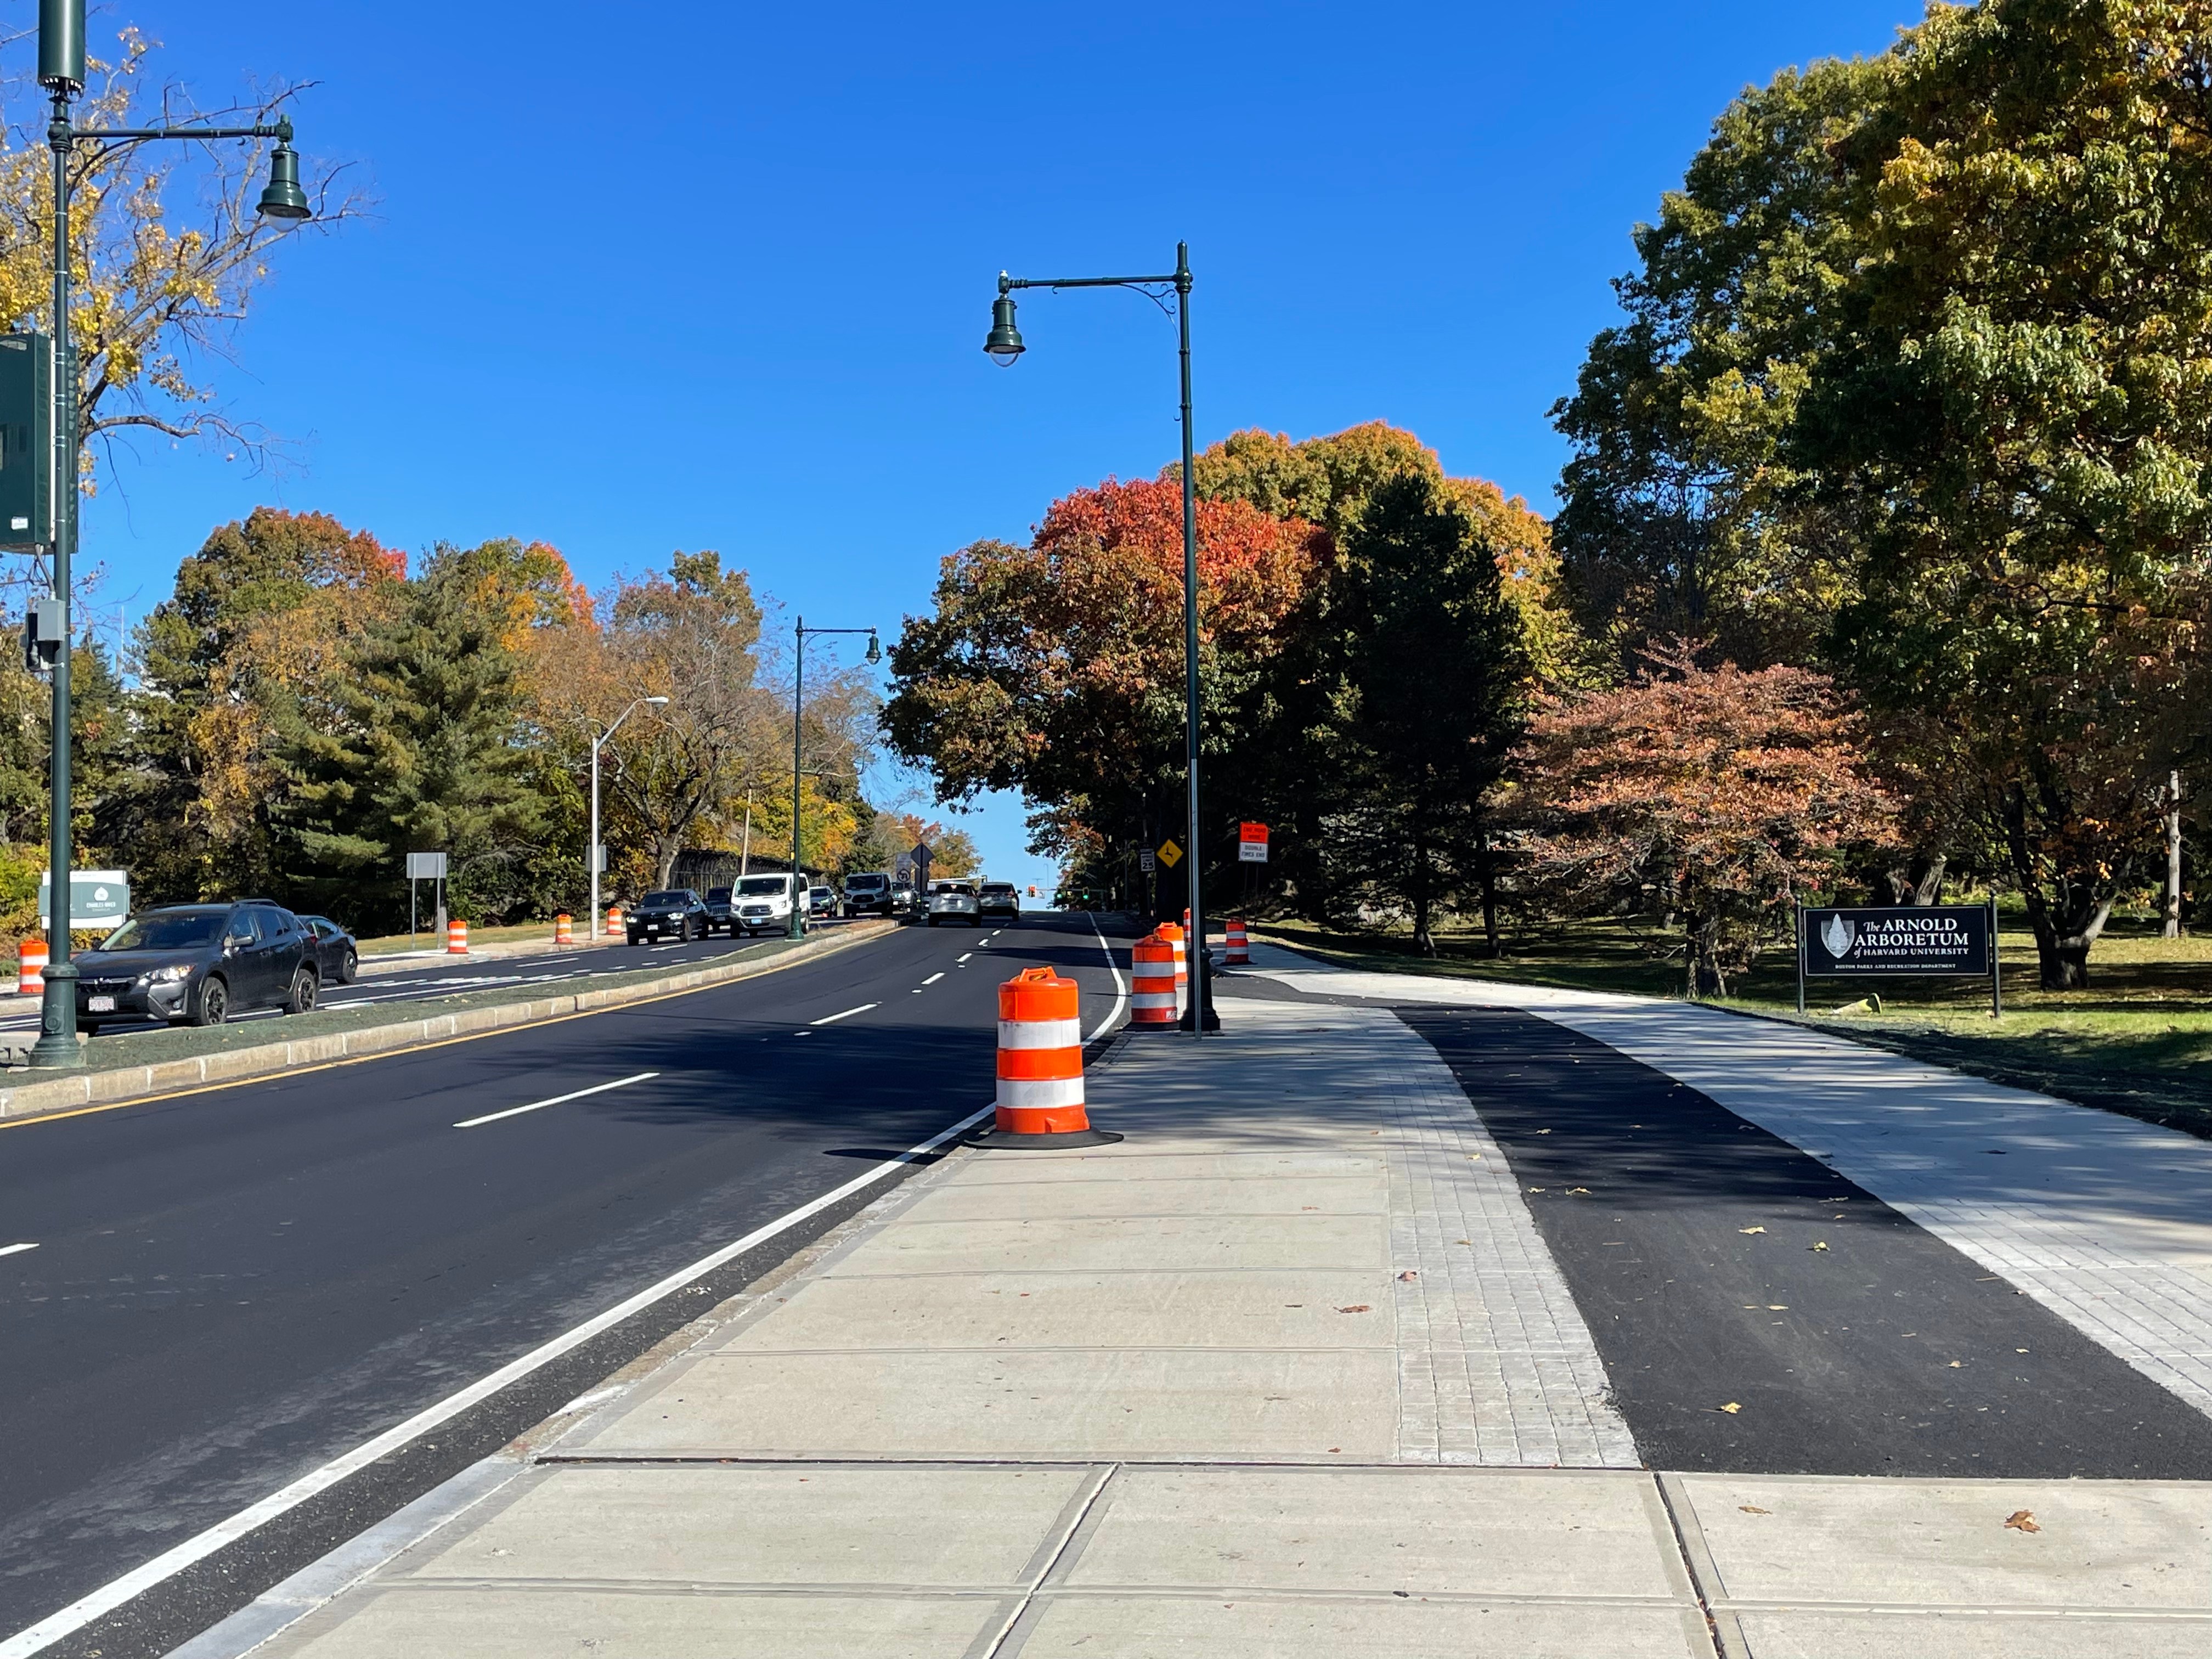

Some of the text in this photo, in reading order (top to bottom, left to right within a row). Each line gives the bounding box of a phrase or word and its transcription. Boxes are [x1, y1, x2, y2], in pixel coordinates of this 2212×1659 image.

[1863, 918, 1957, 932] The ARNOLD
[1855, 933, 1968, 946] ARBORETUM
[1854, 947, 1862, 958] of
[1910, 947, 1969, 956] UNIVERSITY
